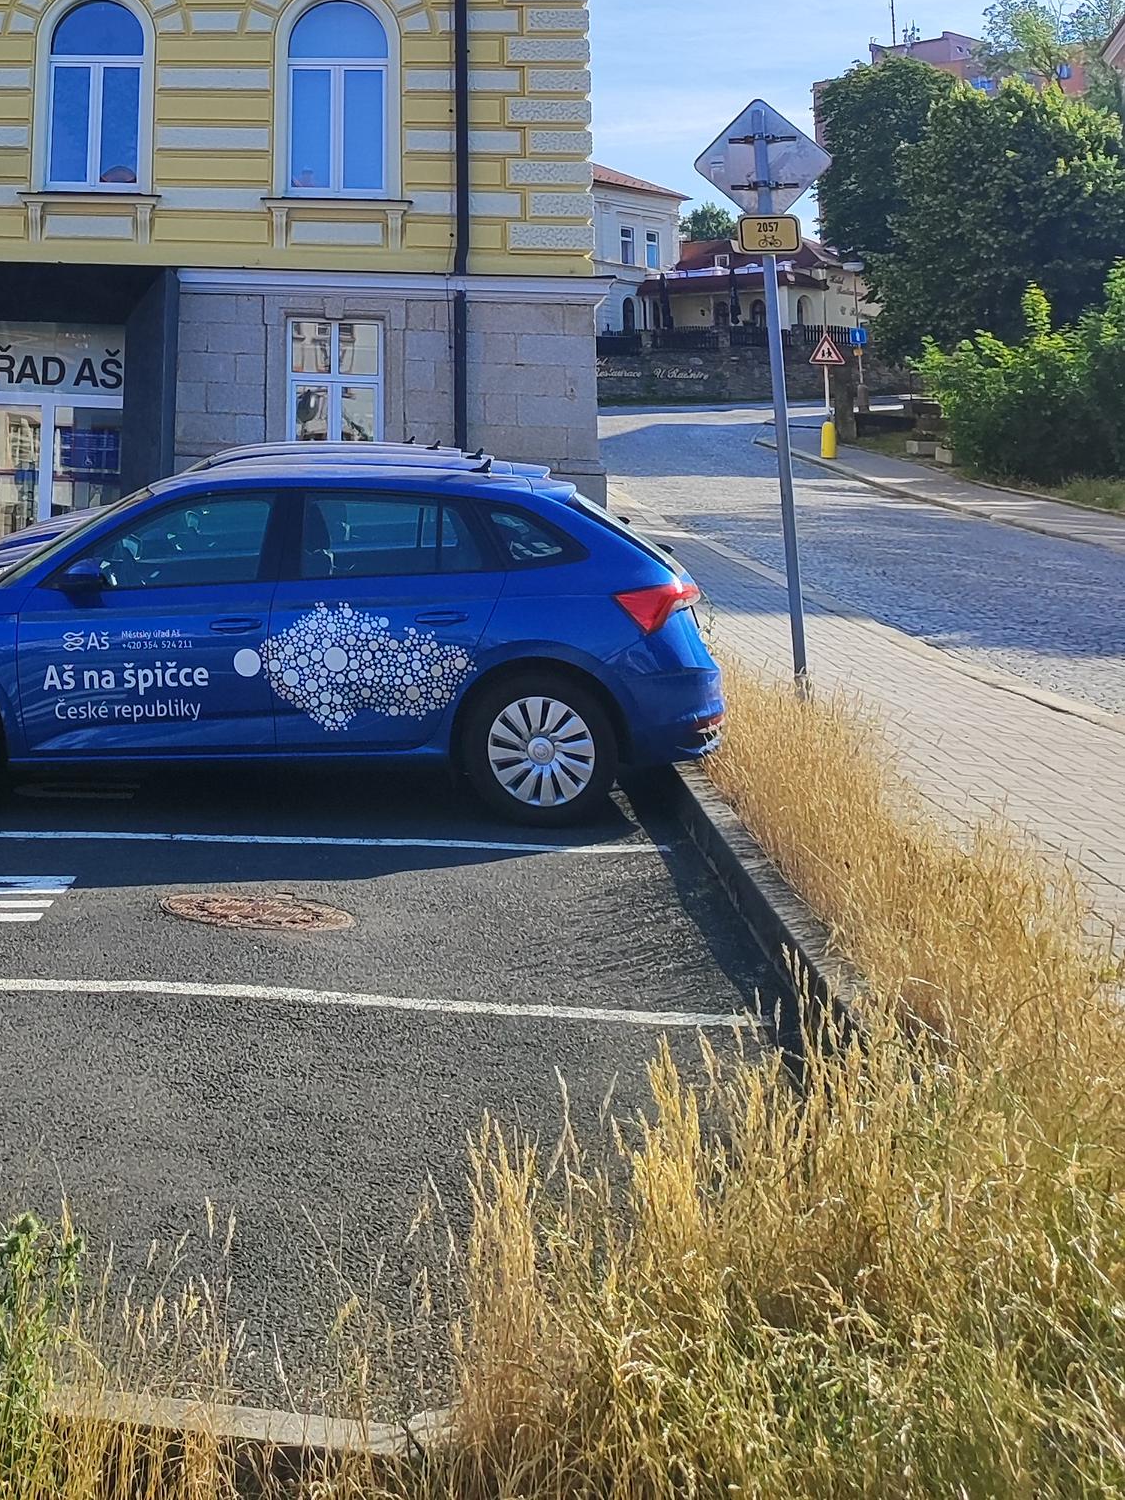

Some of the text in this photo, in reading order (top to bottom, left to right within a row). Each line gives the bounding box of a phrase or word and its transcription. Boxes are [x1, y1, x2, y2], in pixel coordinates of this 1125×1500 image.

[756, 221, 779, 233] 2057
[72, 348, 124, 389] AŠ
[87, 631, 110, 651] Aš
[121, 629, 181, 640] Městský úřad Aš
[122, 641, 142, 650] +420
[161, 640, 177, 649] 524
[177, 639, 193, 649] 211
[43, 661, 210, 696] Aš na špičce
[54, 698, 202, 723] České republiky
